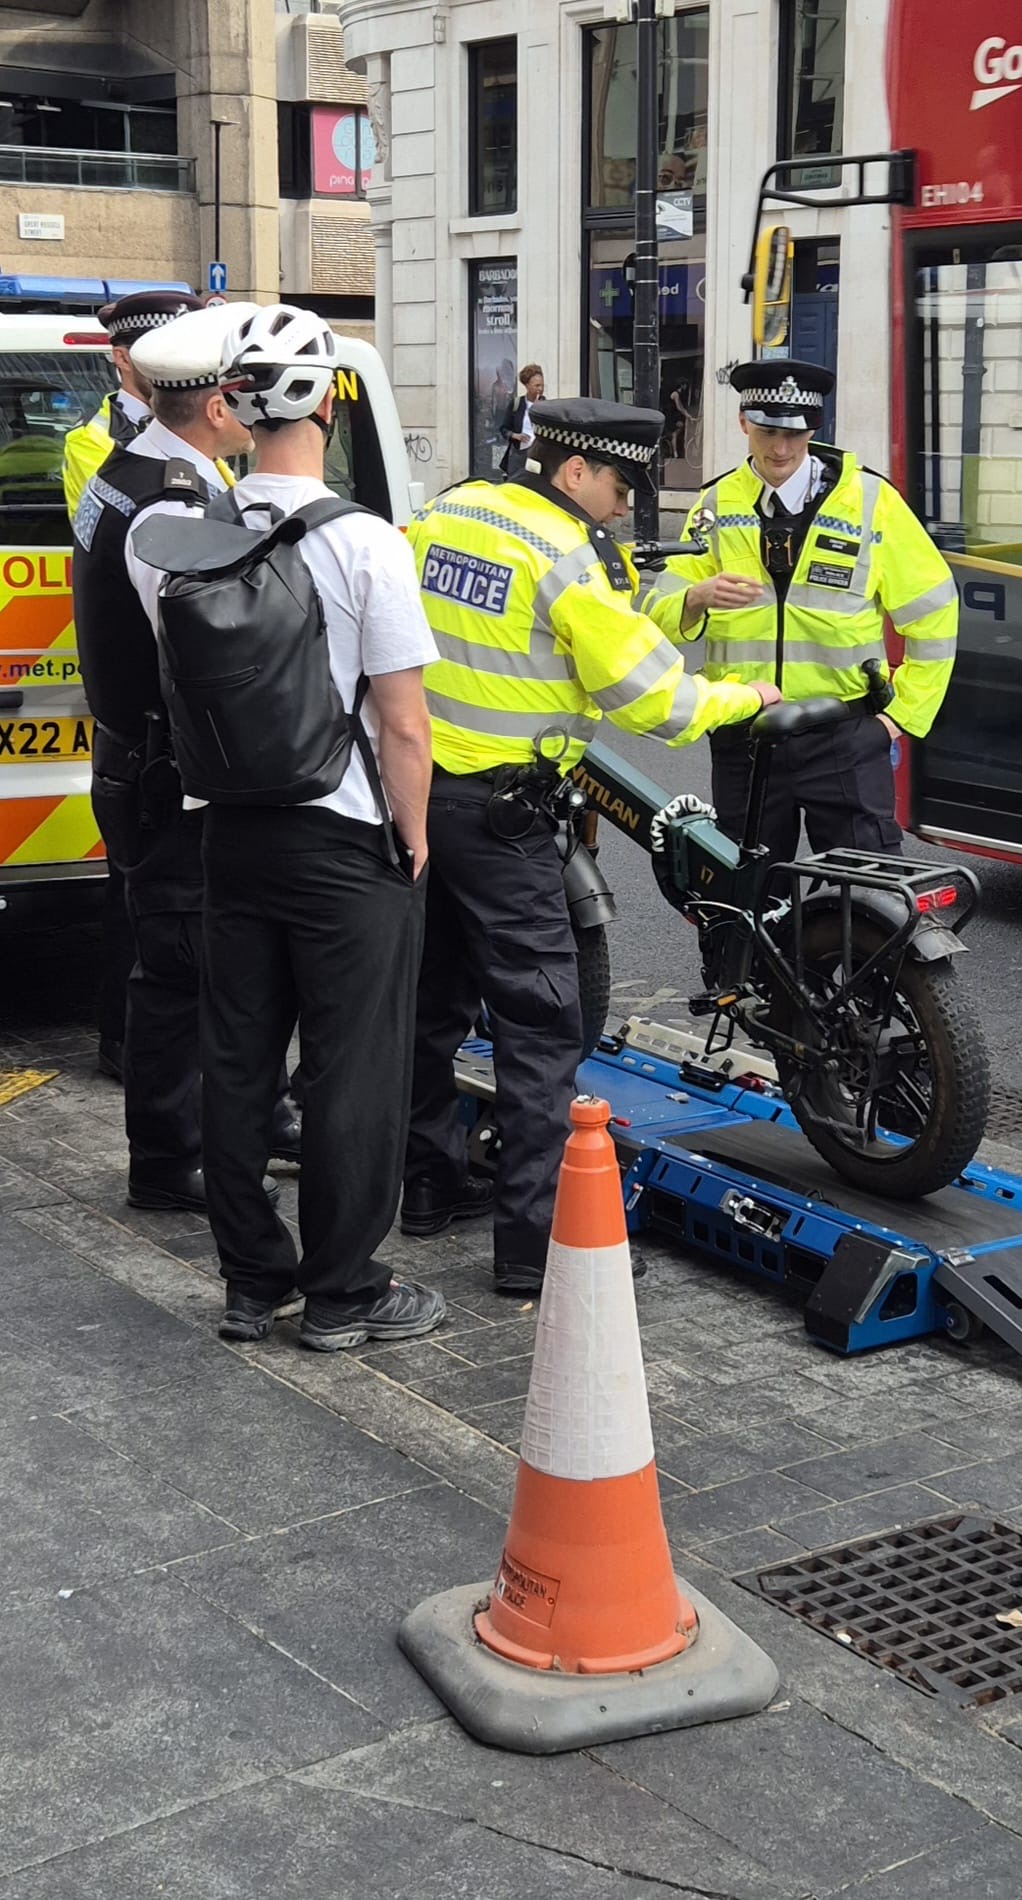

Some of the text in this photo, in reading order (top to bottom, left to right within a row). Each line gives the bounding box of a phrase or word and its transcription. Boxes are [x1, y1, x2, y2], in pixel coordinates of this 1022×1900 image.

[422, 558, 505, 611] POLICE
[430, 545, 510, 580] METROPOLITAN
[572, 765, 641, 830] VITILAN
